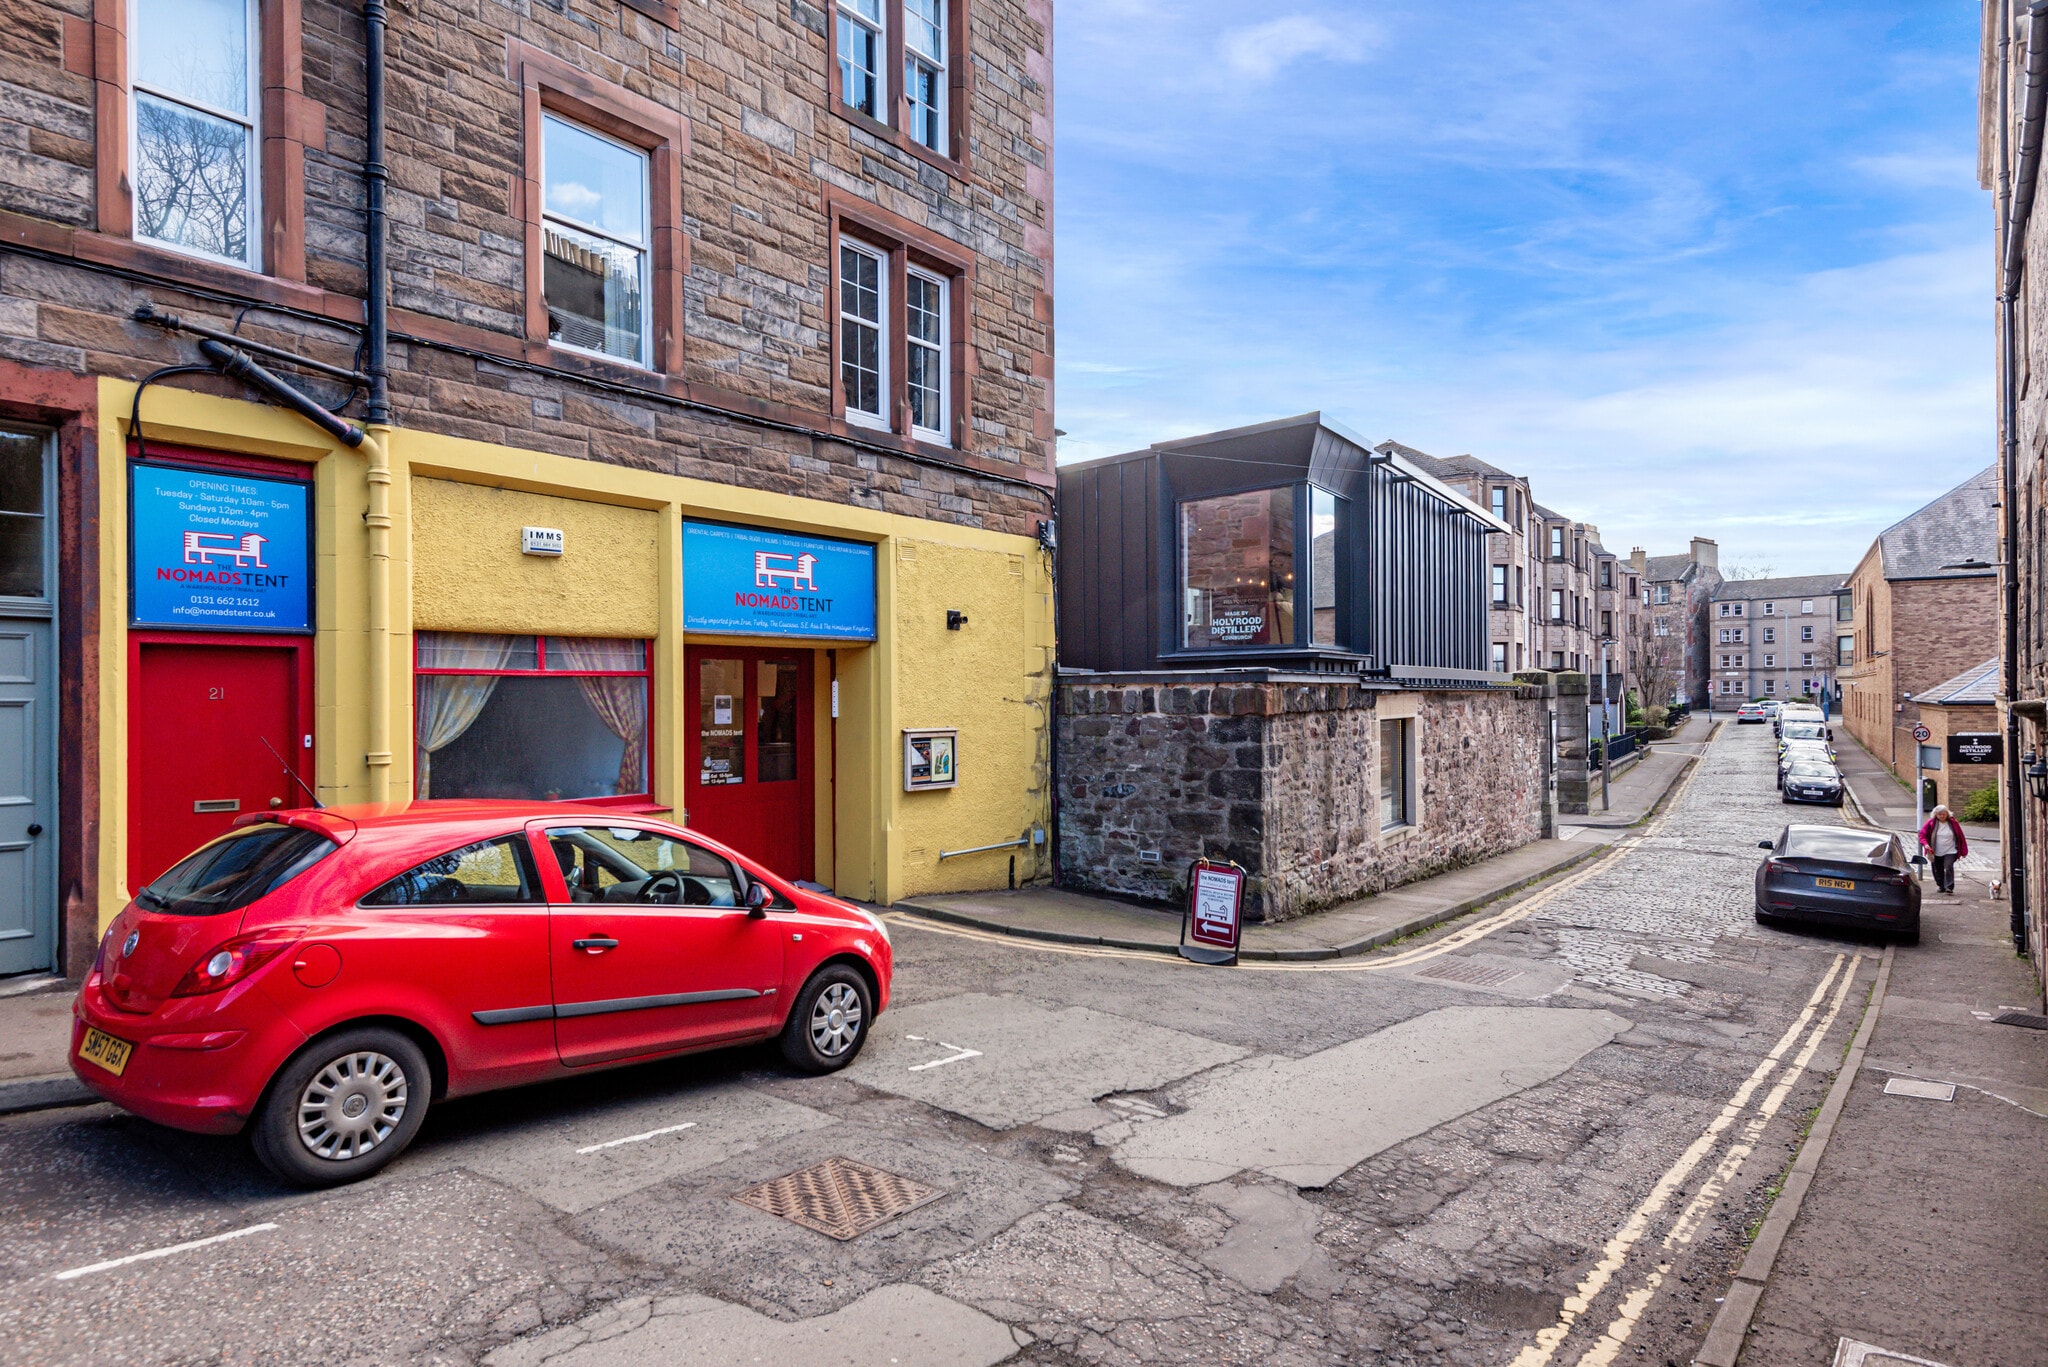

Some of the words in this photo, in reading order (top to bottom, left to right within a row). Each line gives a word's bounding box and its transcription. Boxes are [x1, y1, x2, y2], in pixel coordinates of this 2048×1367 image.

[189, 480, 229, 492] OPENING
[155, 487, 193, 500] Tuesday
[200, 493, 239, 505] Saturday
[241, 497, 265, 507] 10am
[271, 500, 290, 510] 5pm
[179, 502, 216, 513] Sundays
[219, 506, 243, 516] 12pm
[250, 510, 268, 518] 4pm
[189, 514, 219, 524] Closed
[221, 518, 259, 528] Mondays
[530, 531, 562, 541] IMMS
[687, 528, 710, 536] ORIENTAL
[217, 563, 232, 572] THE
[190, 595, 214, 604] 0131
[217, 597, 235, 605] 662
[237, 597, 259, 607] 1612
[172, 606, 276, 618] info@nomadstent.co.uk
[1212, 616, 1261, 626] HOLYROOD
[1212, 625, 1263, 634] DISTILLERY
[209, 687, 224, 700] 21
[1818, 878, 1832, 887] R15
[1834, 879, 1852, 889] NGV
